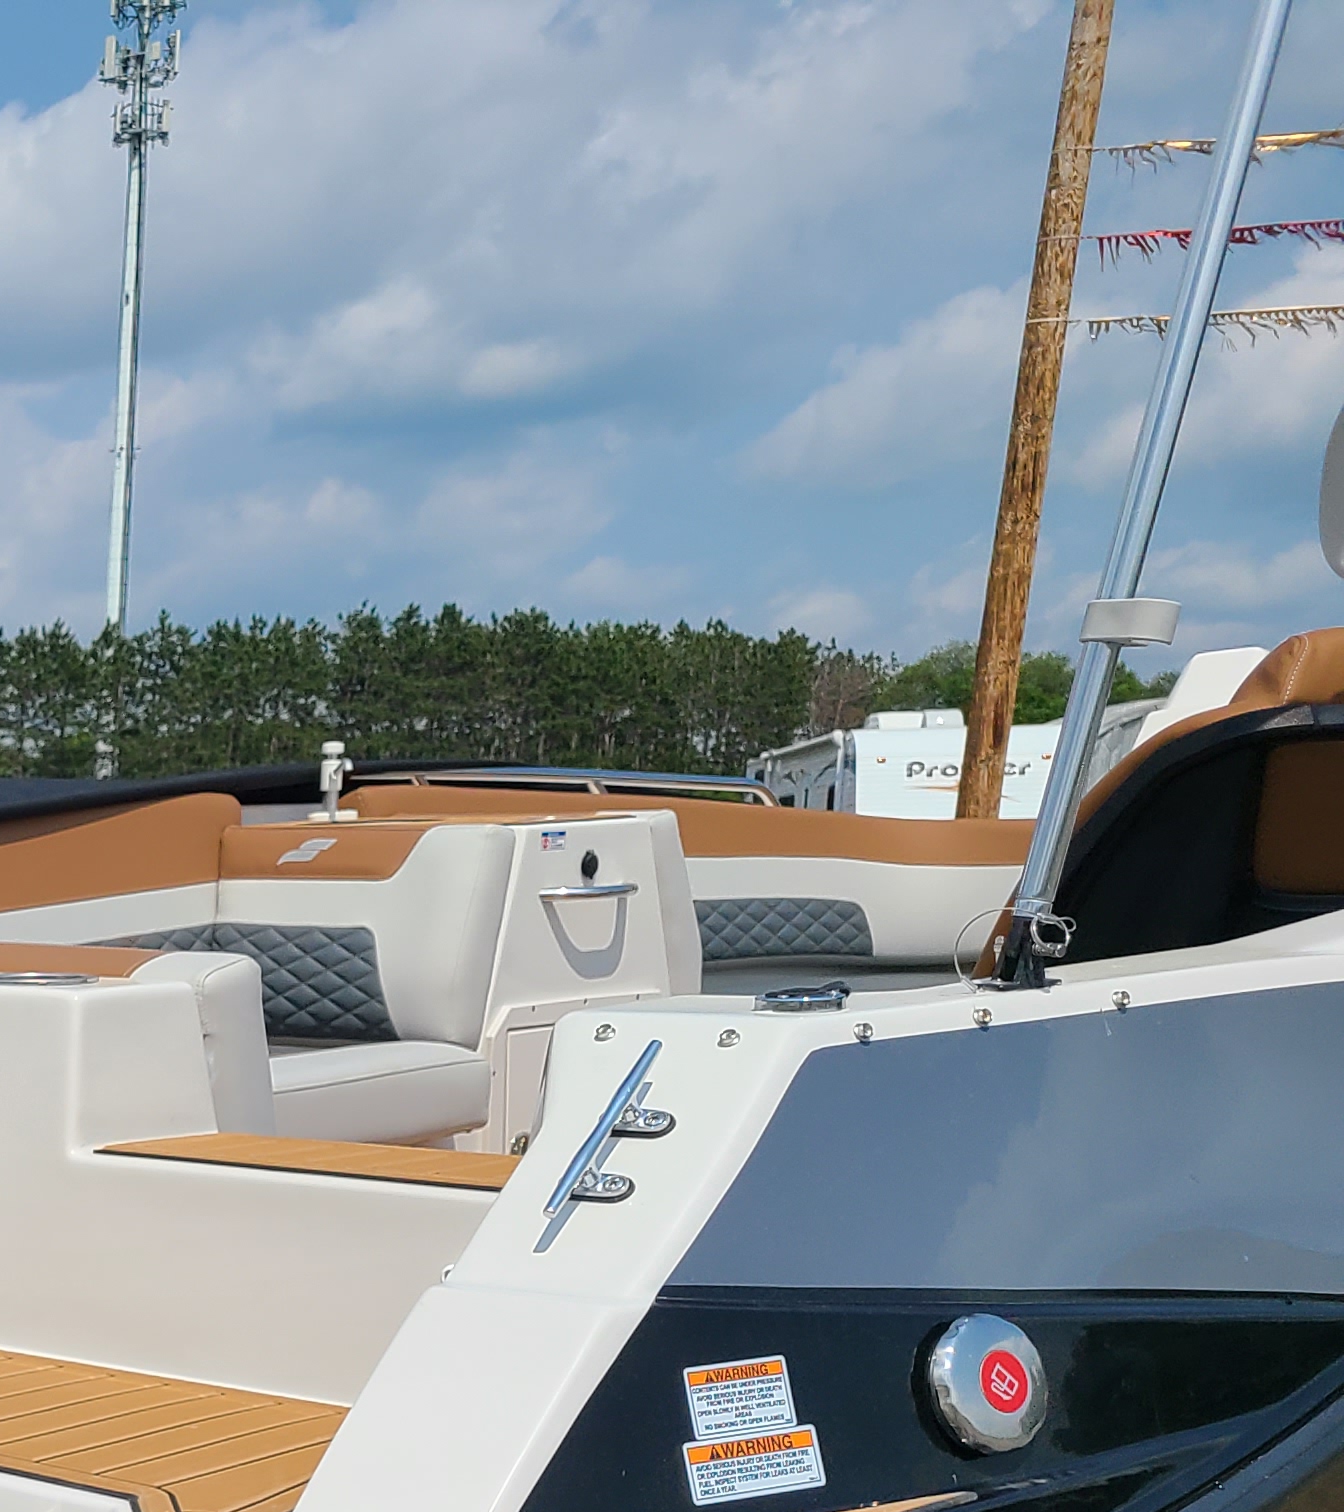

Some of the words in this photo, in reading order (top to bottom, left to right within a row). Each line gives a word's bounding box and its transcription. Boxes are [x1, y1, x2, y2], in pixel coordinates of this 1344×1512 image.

[906, 762, 1030, 777] Proer
[712, 1363, 768, 1381] WARNING
[721, 1434, 793, 1458] WARNING
